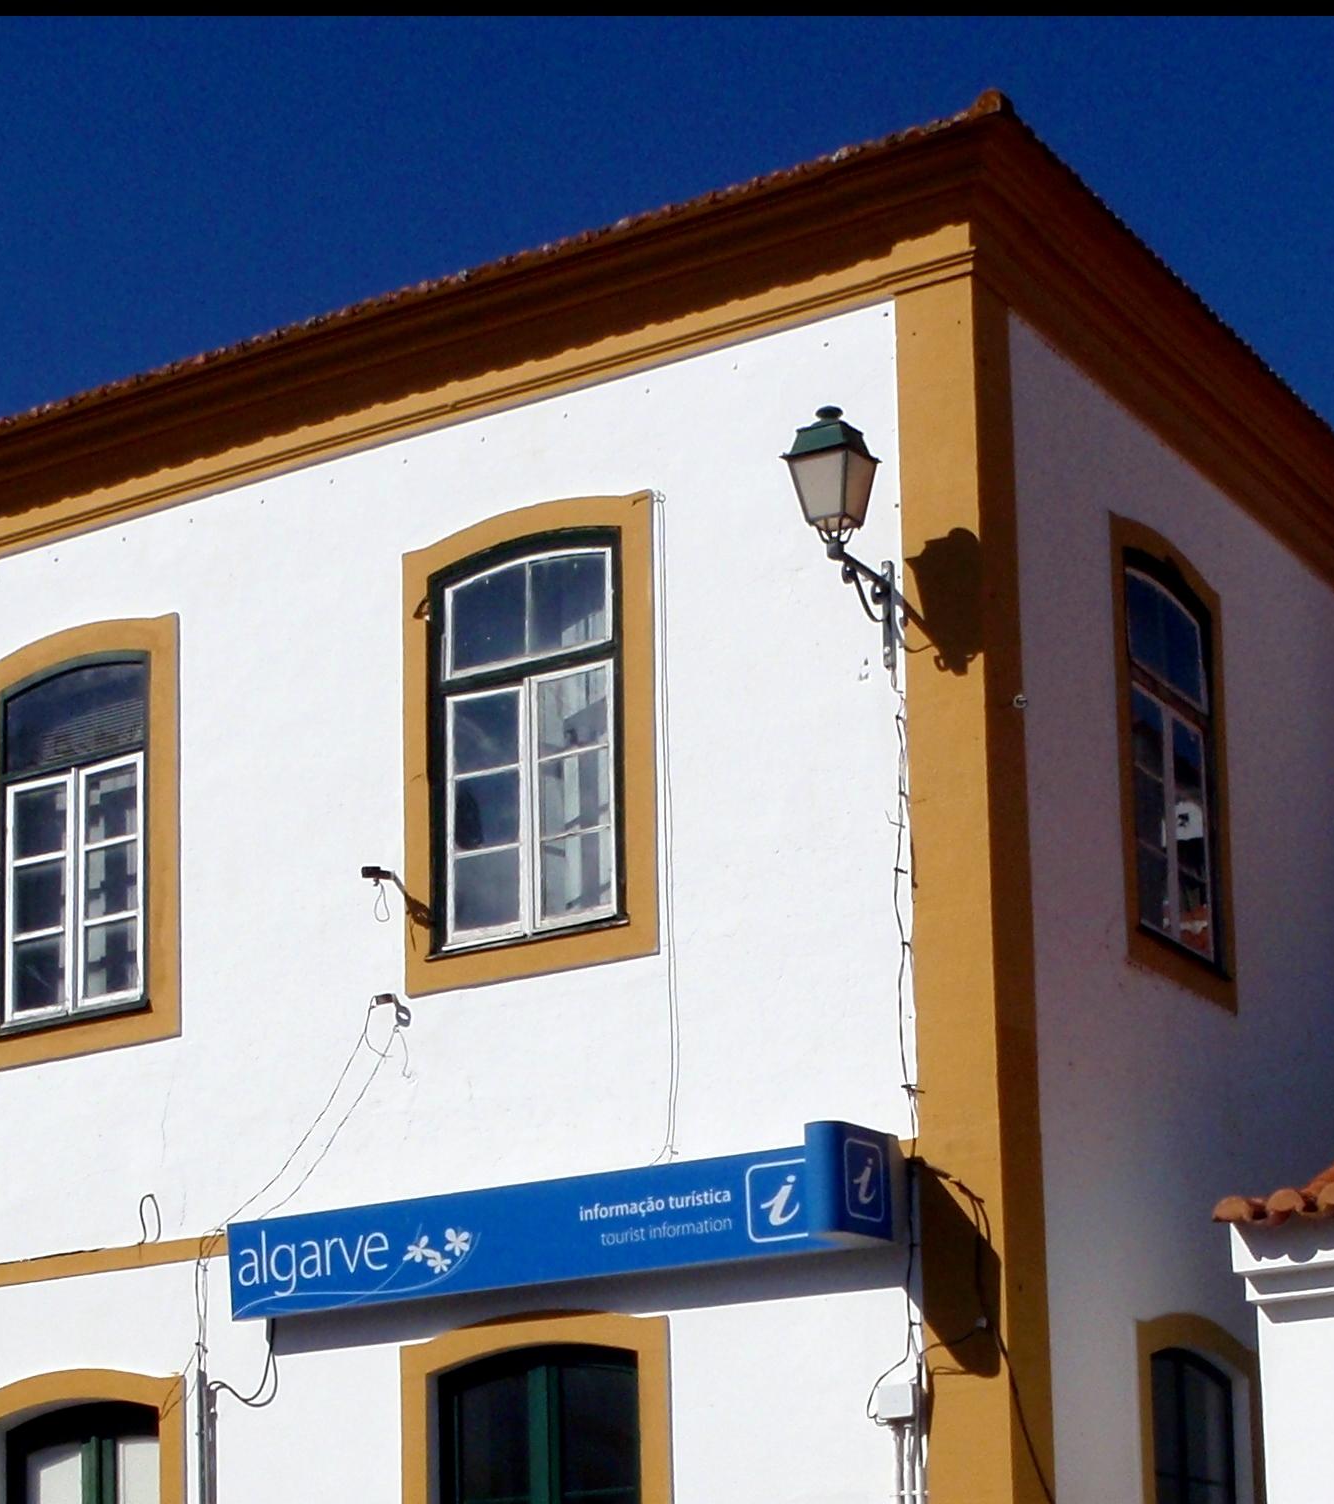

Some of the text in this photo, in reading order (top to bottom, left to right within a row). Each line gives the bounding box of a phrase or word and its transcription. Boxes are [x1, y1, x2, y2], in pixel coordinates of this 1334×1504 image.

[579, 1188, 732, 1221] informação turística
[601, 1216, 733, 1246] tourist information
[237, 1229, 390, 1297] algarve
